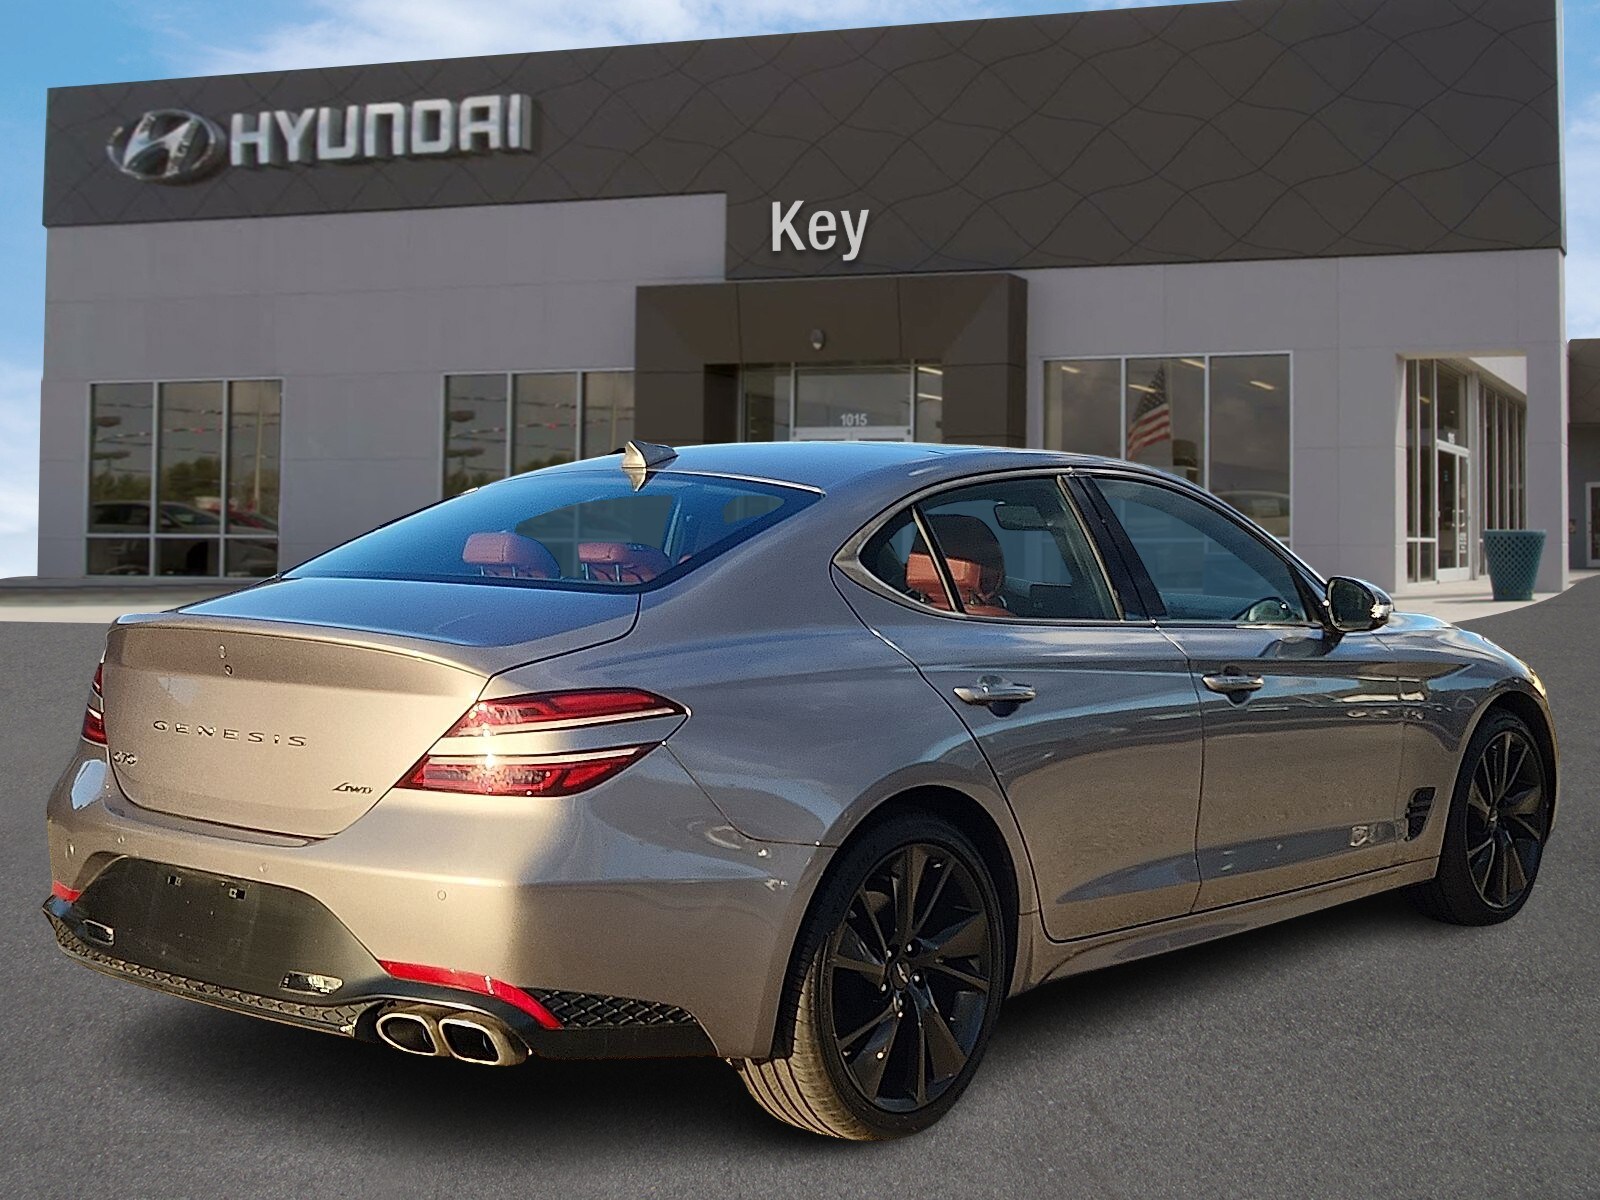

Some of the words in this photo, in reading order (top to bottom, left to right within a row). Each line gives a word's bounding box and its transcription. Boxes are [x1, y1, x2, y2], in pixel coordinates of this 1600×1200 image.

[230, 93, 532, 167] HYUNDAI
[771, 200, 870, 262] Key
[840, 413, 868, 427] 1015
[152, 719, 308, 747] GENESIS
